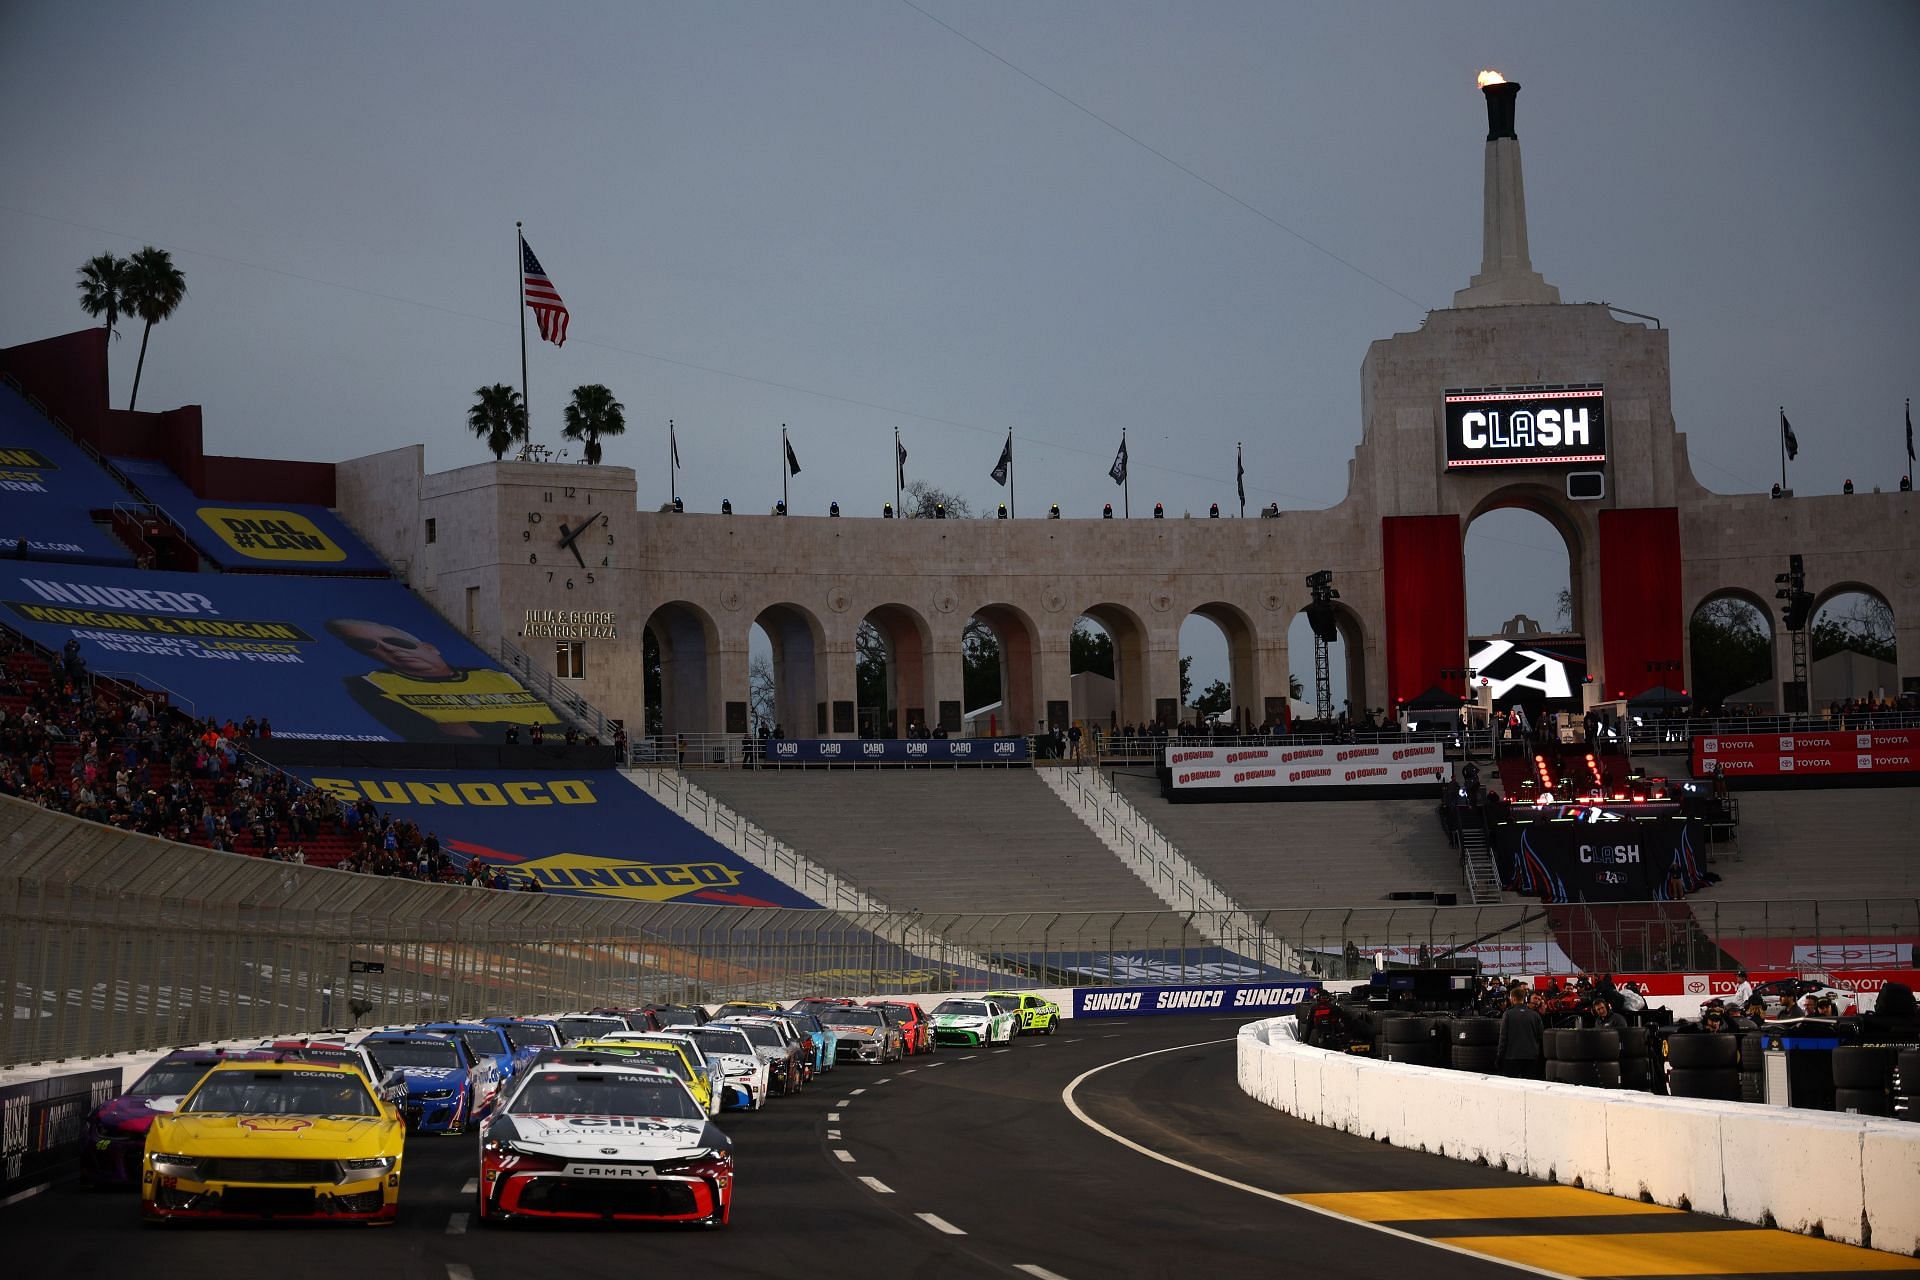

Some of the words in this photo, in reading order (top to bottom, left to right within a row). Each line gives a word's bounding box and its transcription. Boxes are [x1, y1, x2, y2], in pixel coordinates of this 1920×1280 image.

[1462, 407, 1589, 449] CLASH
[545, 492, 552, 503] 11
[565, 487, 576, 498] 12
[528, 512, 542, 524] 10
[602, 516, 609, 527] 2
[220, 518, 304, 535] DIAL
[234, 533, 326, 550] #LAW
[523, 531, 530, 542] 9
[608, 535, 614, 546] 3
[530, 554, 537, 564] 8
[602, 556, 608, 567] 4
[547, 572, 553, 582] 7
[587, 573, 594, 583] 5
[567, 579, 573, 589] 6
[20, 578, 220, 614] INJURED?
[20, 604, 150, 632] MORGAN
[148, 617, 178, 633] &
[177, 619, 298, 640] MORGAN
[526, 610, 555, 624] JULIA
[558, 611, 568, 624] &
[570, 611, 616, 625] GEORGE
[524, 623, 577, 638] ARGYROS
[580, 626, 617, 639] PLAZA
[70, 629, 200, 649] AMERICA'S
[200, 640, 302, 654] LARGEST
[97, 640, 184, 657] INJURY
[186, 648, 240, 661] LAW
[239, 653, 304, 664] FIRM
[1720, 741, 1755, 750] TOYOTA
[1795, 739, 1831, 747] TOYOTA
[1873, 736, 1909, 745] TOYOTA
[776, 743, 798, 754] CABO
[820, 743, 841, 754] CABO
[863, 743, 884, 754] CABO
[906, 742, 928, 754] CABO
[950, 742, 971, 753] CABO
[993, 742, 1015, 753] CABO
[1392, 751, 1403, 760] GO
[1404, 747, 1435, 757] BOWLING
[1172, 753, 1182, 763] GO
[1184, 751, 1213, 760] BOWLING
[1226, 753, 1237, 763] GO
[1238, 751, 1268, 760] BOWLING
[1281, 753, 1292, 762] GO
[1293, 749, 1323, 760] BOWLING
[1337, 752, 1347, 761] GO
[1349, 748, 1379, 758] BOWLING
[1874, 756, 1910, 765] TOYOTA
[1719, 760, 1754, 769] TOYOTA
[1796, 758, 1831, 767] TOYOTA
[1179, 774, 1189, 784] GO
[1190, 770, 1220, 781] BOWLING
[1234, 773, 1244, 783] GO
[1245, 769, 1276, 779] BOWLING
[1289, 772, 1300, 782] GO
[1301, 768, 1331, 779] BOWLING
[1345, 771, 1356, 781] GO
[1357, 767, 1387, 778] BOWLING
[1401, 770, 1412, 780] GO
[1413, 766, 1444, 777] BOWLING
[312, 778, 598, 806] SUNOCO
[1579, 844, 1640, 864] CLASH
[501, 866, 731, 886] SUNOCO
[1711, 981, 1769, 993] TOYTA
[1831, 979, 1888, 991] TOYOTA
[1083, 992, 1142, 1011] SUNOCO
[1156, 990, 1224, 1009] SUNOCO
[1233, 987, 1306, 1007] SUNOCO
[1023, 1012, 1033, 1026] 12
[294, 1071, 345, 1079] LOGANO
[618, 1075, 672, 1085] HAMLIN
[573, 1167, 649, 1176] CAMRY
